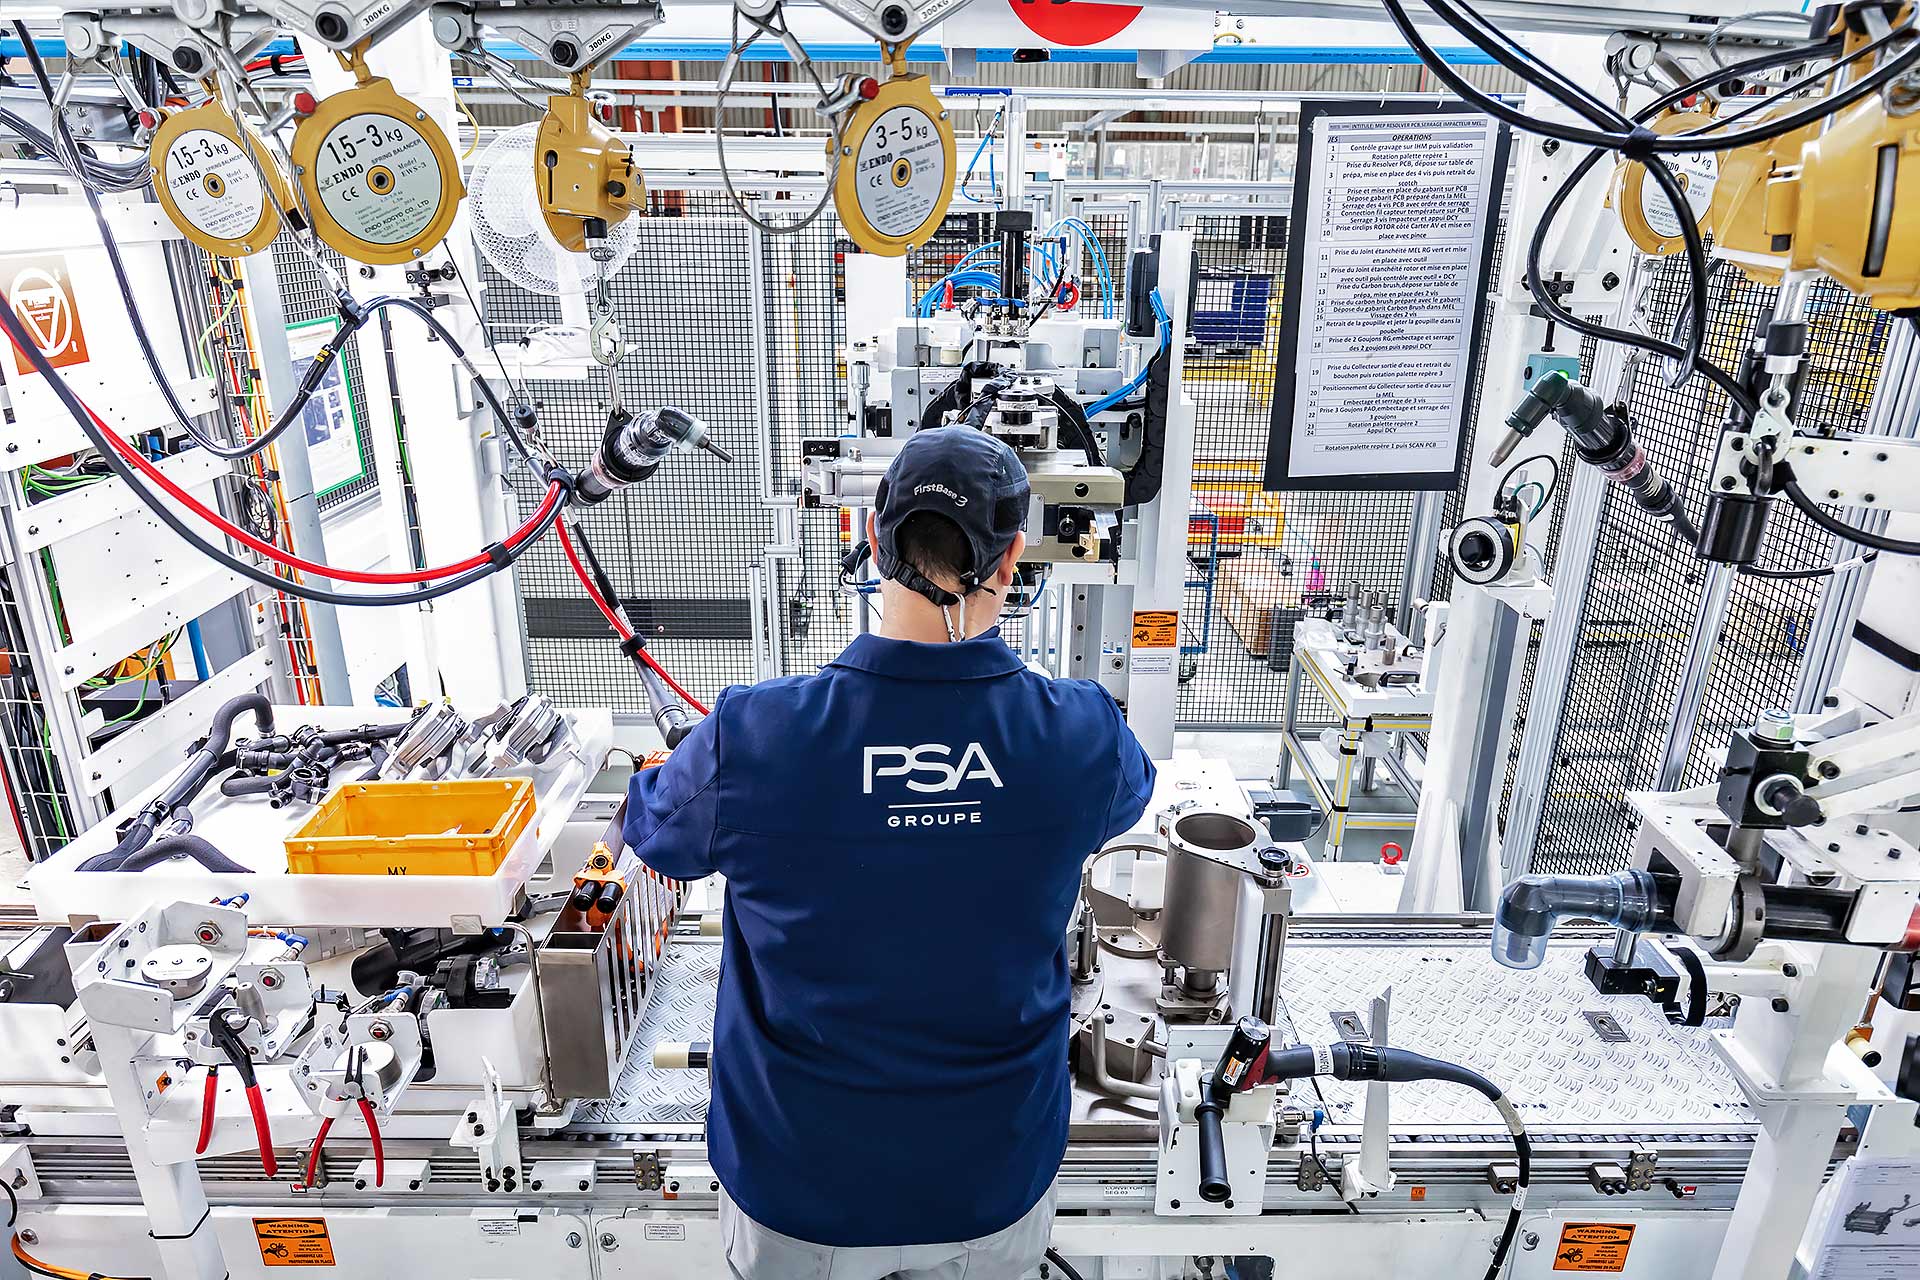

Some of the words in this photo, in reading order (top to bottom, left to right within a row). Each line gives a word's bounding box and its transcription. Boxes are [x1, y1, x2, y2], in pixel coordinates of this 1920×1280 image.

[362, 6, 391, 26] 300KG
[921, 0, 949, 19] 300KG
[588, 32, 612, 52] 300KG
[385, 128, 403, 143] kg
[916, 126, 928, 139] kg
[214, 143, 229, 155] kg
[371, 153, 393, 164] SPRING
[393, 138, 422, 157] BALANCER
[1428, 143, 1441, 151] puis
[869, 152, 893, 169] ENDO
[1399, 152, 1421, 160] palette
[398, 157, 417, 170] Model
[1702, 156, 1712, 170] kg
[332, 163, 365, 185] ENDO
[401, 162, 427, 178] EWS-3
[1388, 170, 1404, 178] place
[178, 170, 201, 186] ENDO
[1342, 202, 1364, 210] Serrage
[382, 211, 403, 227] KOGYO
[417, 199, 430, 209] LTD
[1381, 257, 1397, 265] place
[1451, 264, 1467, 272] place
[1362, 319, 1385, 327] goupille
[1393, 318, 1407, 326] jeter
[1415, 318, 1439, 326] goupille
[1380, 328, 1404, 336] poubelle
[1359, 372, 1371, 380] puis
[1396, 371, 1417, 379] palette
[1372, 420, 1393, 428] palette
[1350, 443, 1369, 451] palette
[914, 484, 957, 499] FirstBase
[955, 496, 968, 507] 3
[863, 743, 1004, 793] PSA
[887, 812, 982, 828] GROUPE
